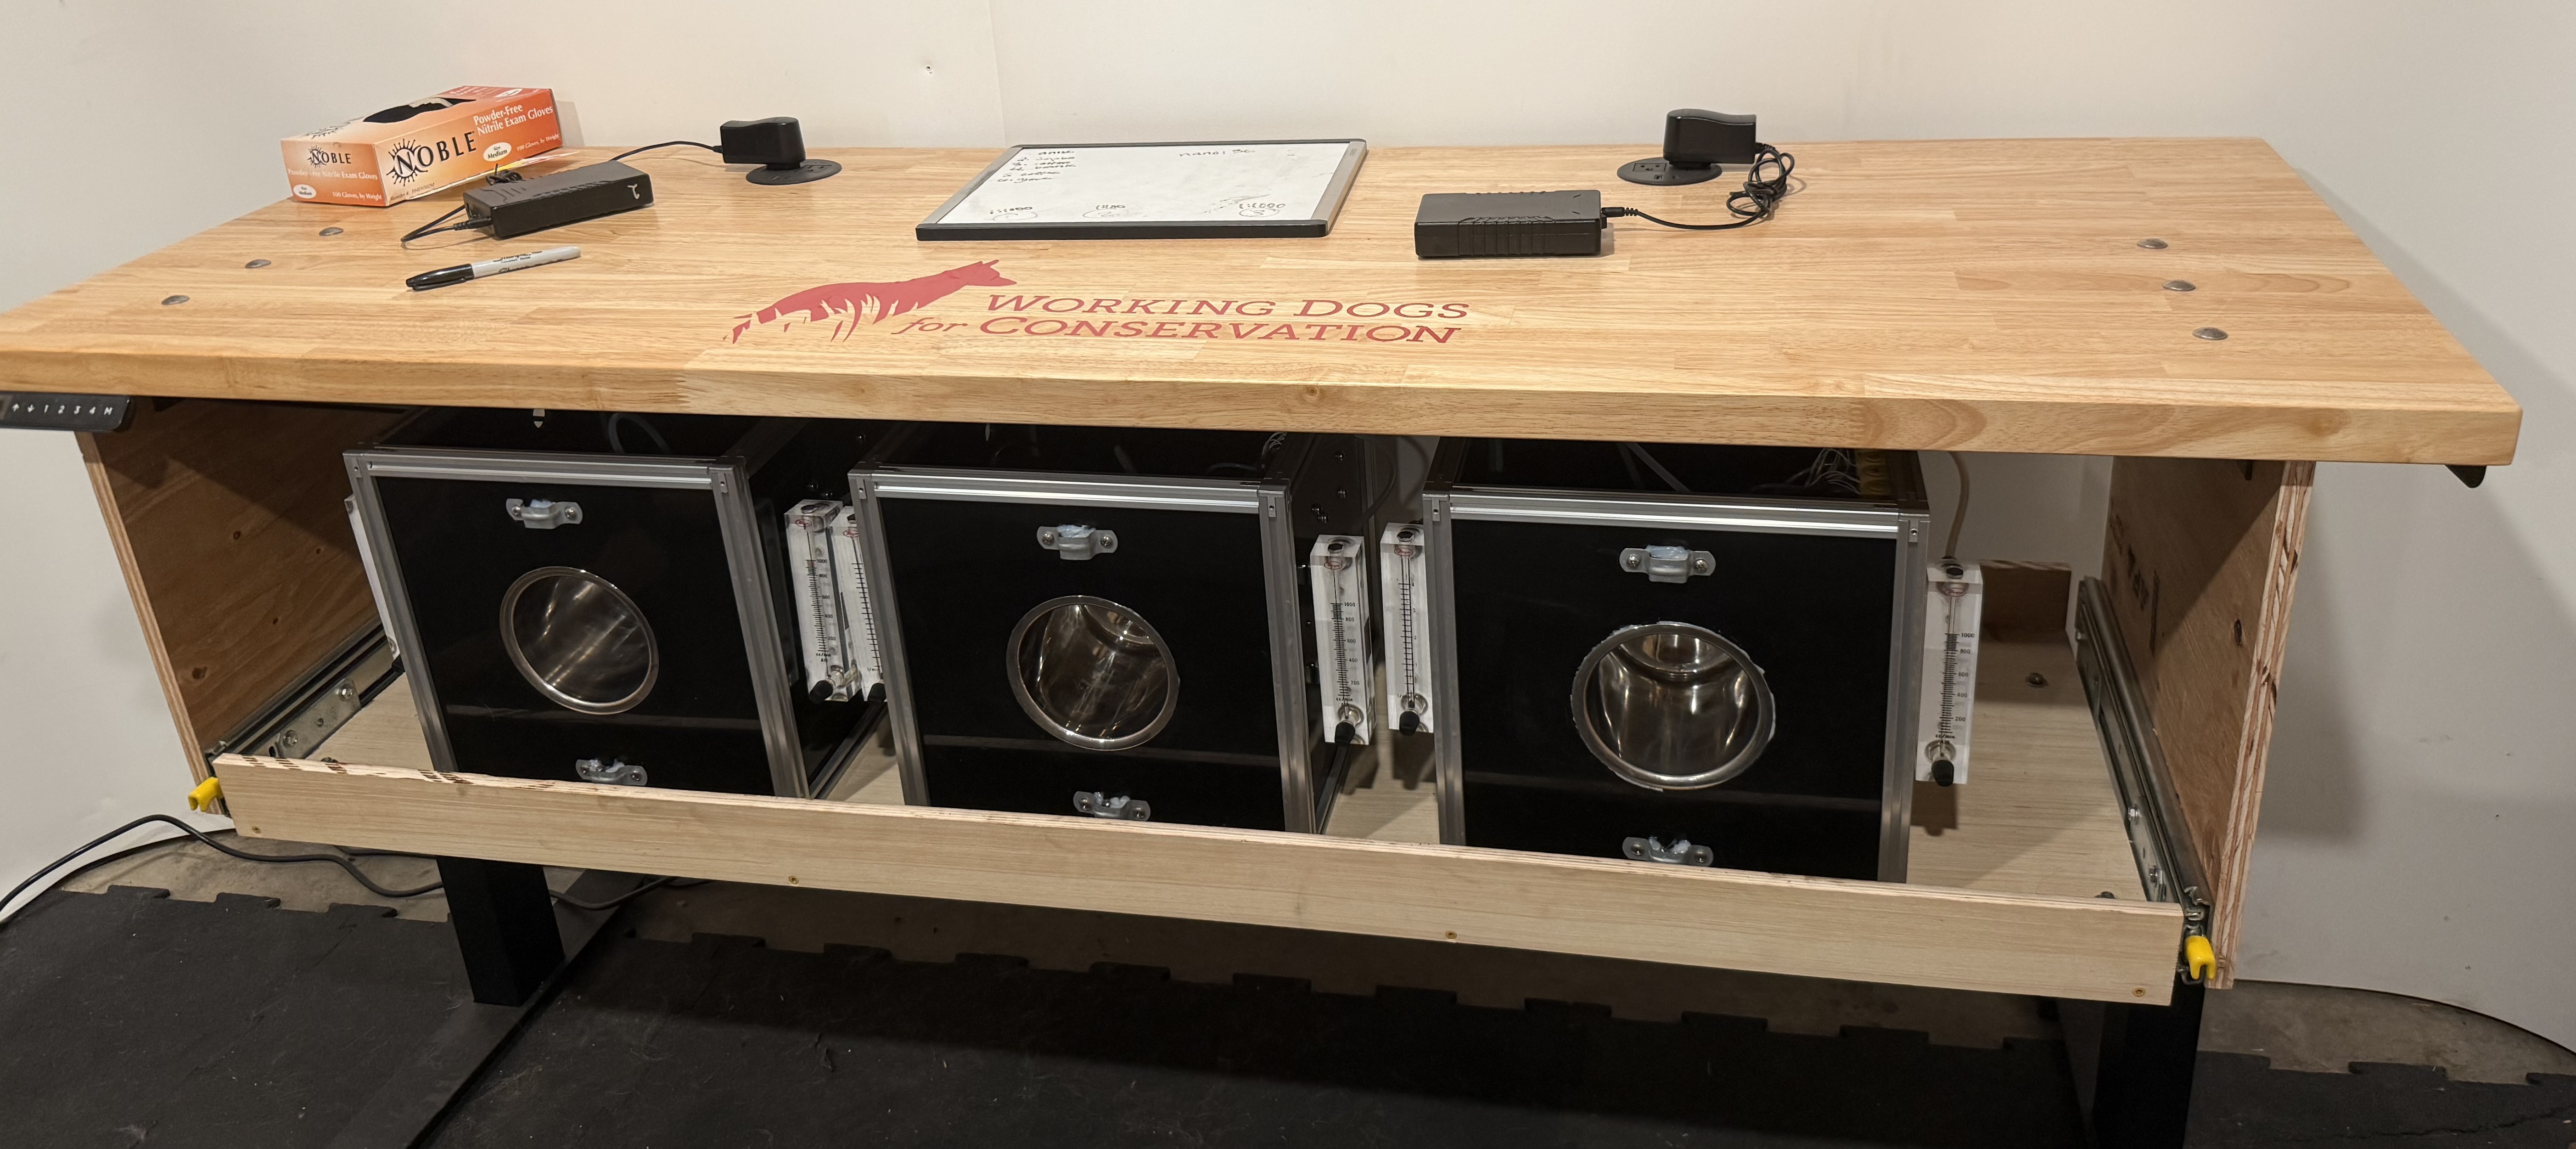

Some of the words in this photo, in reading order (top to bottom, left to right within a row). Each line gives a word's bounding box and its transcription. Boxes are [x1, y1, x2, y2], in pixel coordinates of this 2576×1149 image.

[473, 105, 523, 125] Powder-Free
[477, 122, 504, 136] Nitrile
[505, 114, 527, 127] Exam
[528, 106, 553, 119] Gloves
[311, 152, 352, 164] NOBLE
[397, 131, 477, 175] NOBLE
[359, 172, 378, 180] Gloves
[988, 294, 1276, 315] WORKING
[1293, 299, 1470, 318] DOGS
[891, 317, 968, 334] for
[980, 316, 1462, 344] CONSERVATION
[44, 405, 49, 413] 1
[58, 405, 65, 414] 2
[74, 406, 81, 414] 3
